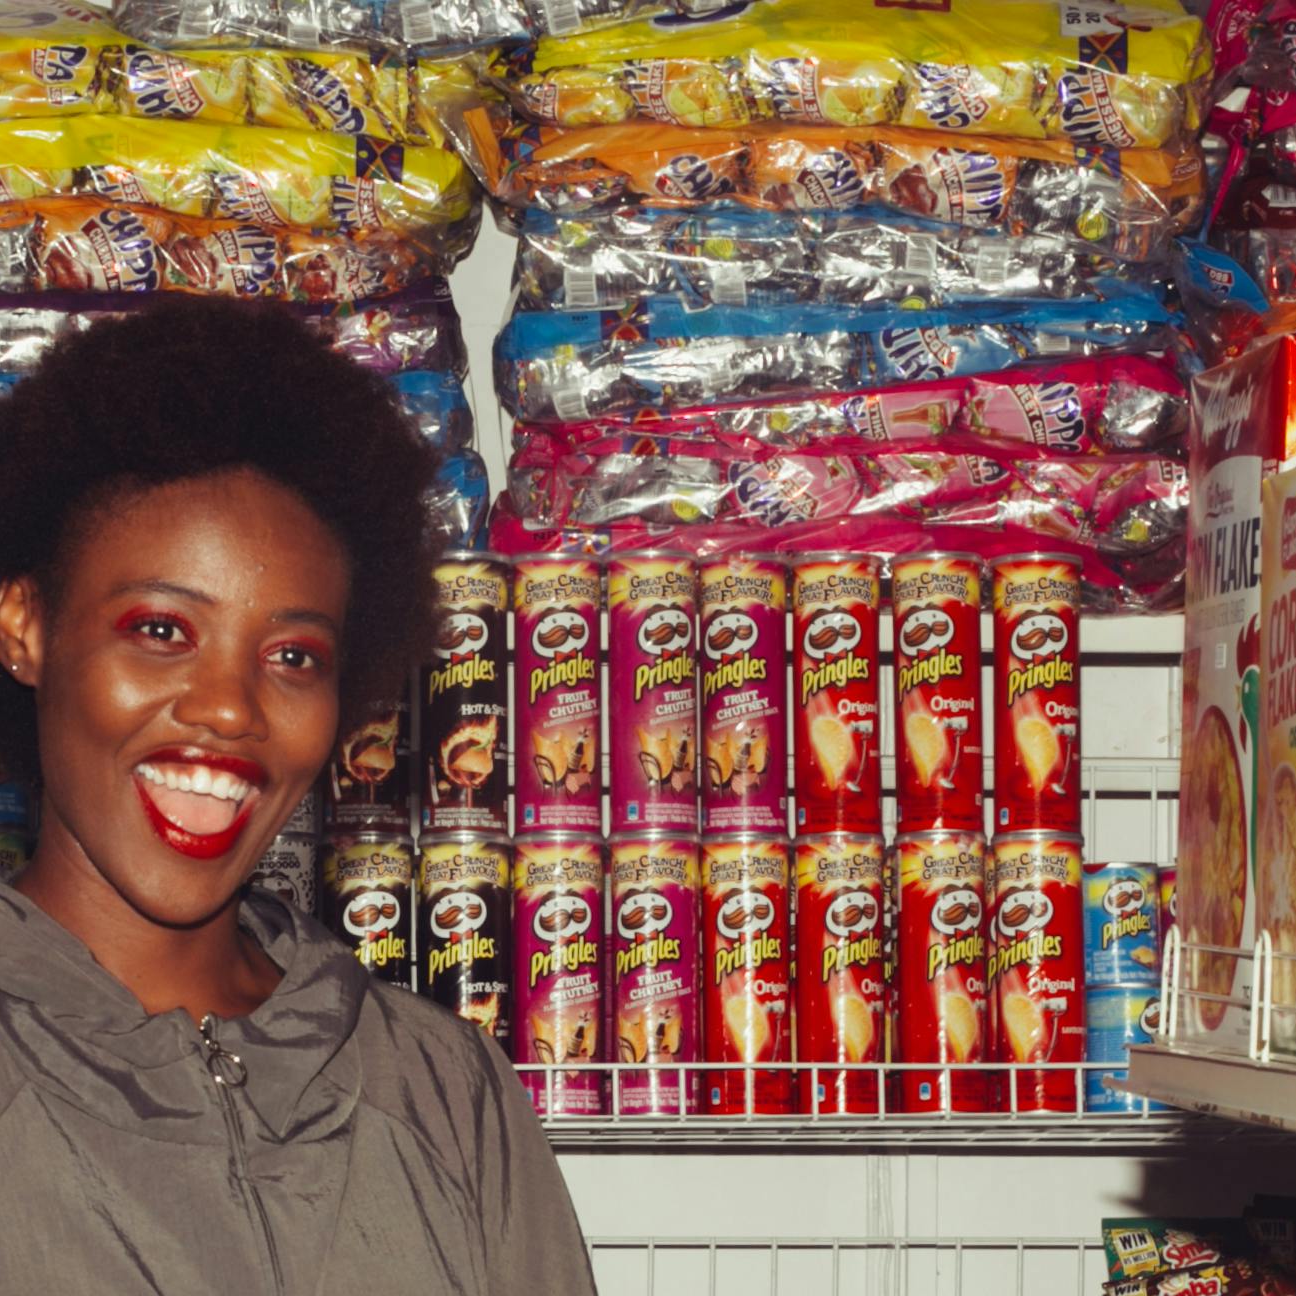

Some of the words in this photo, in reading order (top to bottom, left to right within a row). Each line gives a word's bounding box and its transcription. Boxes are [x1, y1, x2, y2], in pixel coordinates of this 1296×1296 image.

[724, 575, 774, 592] CRUNCH!
[826, 574, 873, 591] CRUNCH!
[920, 572, 968, 588] CRUNCH!
[720, 586, 776, 603] FLAVOUR!
[824, 586, 875, 602] FLAVOUR!
[916, 584, 969, 600] FLAVOUR!
[430, 655, 495, 702] Pringles
[530, 656, 596, 703] Pringles
[634, 656, 695, 702] Pringle
[704, 655, 767, 701] Pringles
[802, 655, 870, 704] Pringles
[898, 651, 963, 700] Pringles
[1007, 657, 1074, 706] Pringles
[556, 689, 591, 705] FRUIT
[663, 689, 693, 703] FRUIT
[723, 690, 760, 706] FRUIT
[930, 695, 975, 713] Original
[548, 699, 598, 719] CHUTNEY
[715, 699, 770, 720] CHUTNEY
[453, 854, 500, 870] CRUNCH!
[640, 855, 687, 871] CRUNCH!
[1020, 853, 1069, 869] CRUNCH!
[449, 866, 502, 882] FLAVOUR!
[1102, 913, 1151, 948] Pringles
[355, 936, 405, 968] ingles
[429, 936, 496, 984] Pringles
[531, 936, 597, 986] Pringles
[616, 937, 680, 983] Pringles
[715, 937, 782, 984] Pringles
[928, 931, 984, 980] Pringle
[997, 933, 1062, 976] Pringles
[557, 972, 592, 989] FRUIT
[638, 969, 672, 986] FRUIT
[1027, 976, 1075, 994] Original
[629, 978, 683, 1000] CHUTNEY
[1119, 1233, 1148, 1251] WIN
[1114, 1282, 1141, 1296] WIN
